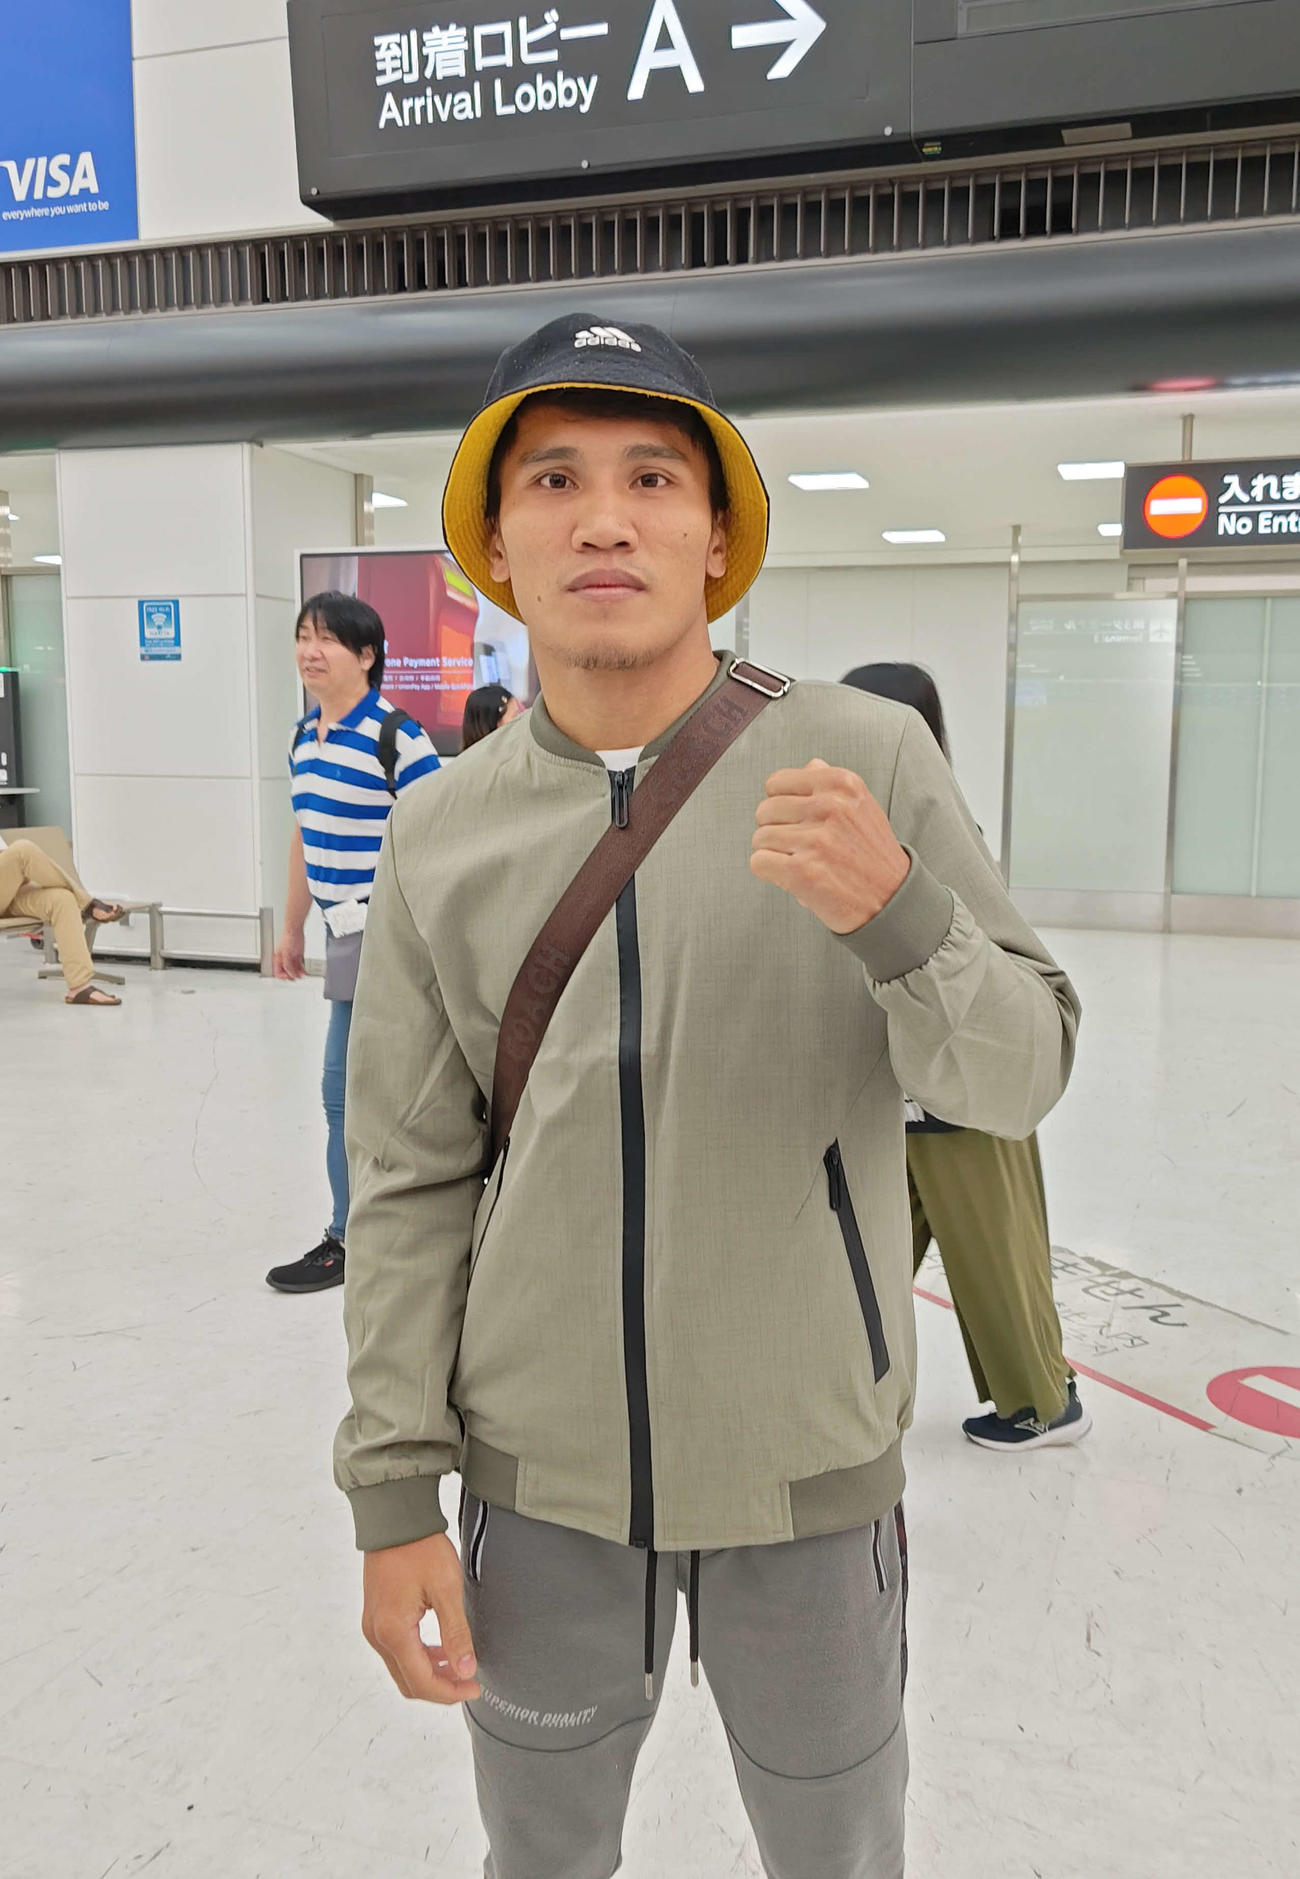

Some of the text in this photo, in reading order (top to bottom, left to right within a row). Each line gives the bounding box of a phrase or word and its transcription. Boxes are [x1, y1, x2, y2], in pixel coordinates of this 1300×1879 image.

[373, 8, 609, 86] 到着ロビー
[627, 0, 705, 101] A
[378, 70, 598, 129] Arrival Lobby
[0, 151, 99, 202] VISA
[2, 200, 110, 220] everywhere you want to be
[1217, 511, 1300, 535] No Ent
[384, 656, 474, 669] one Payment Service
